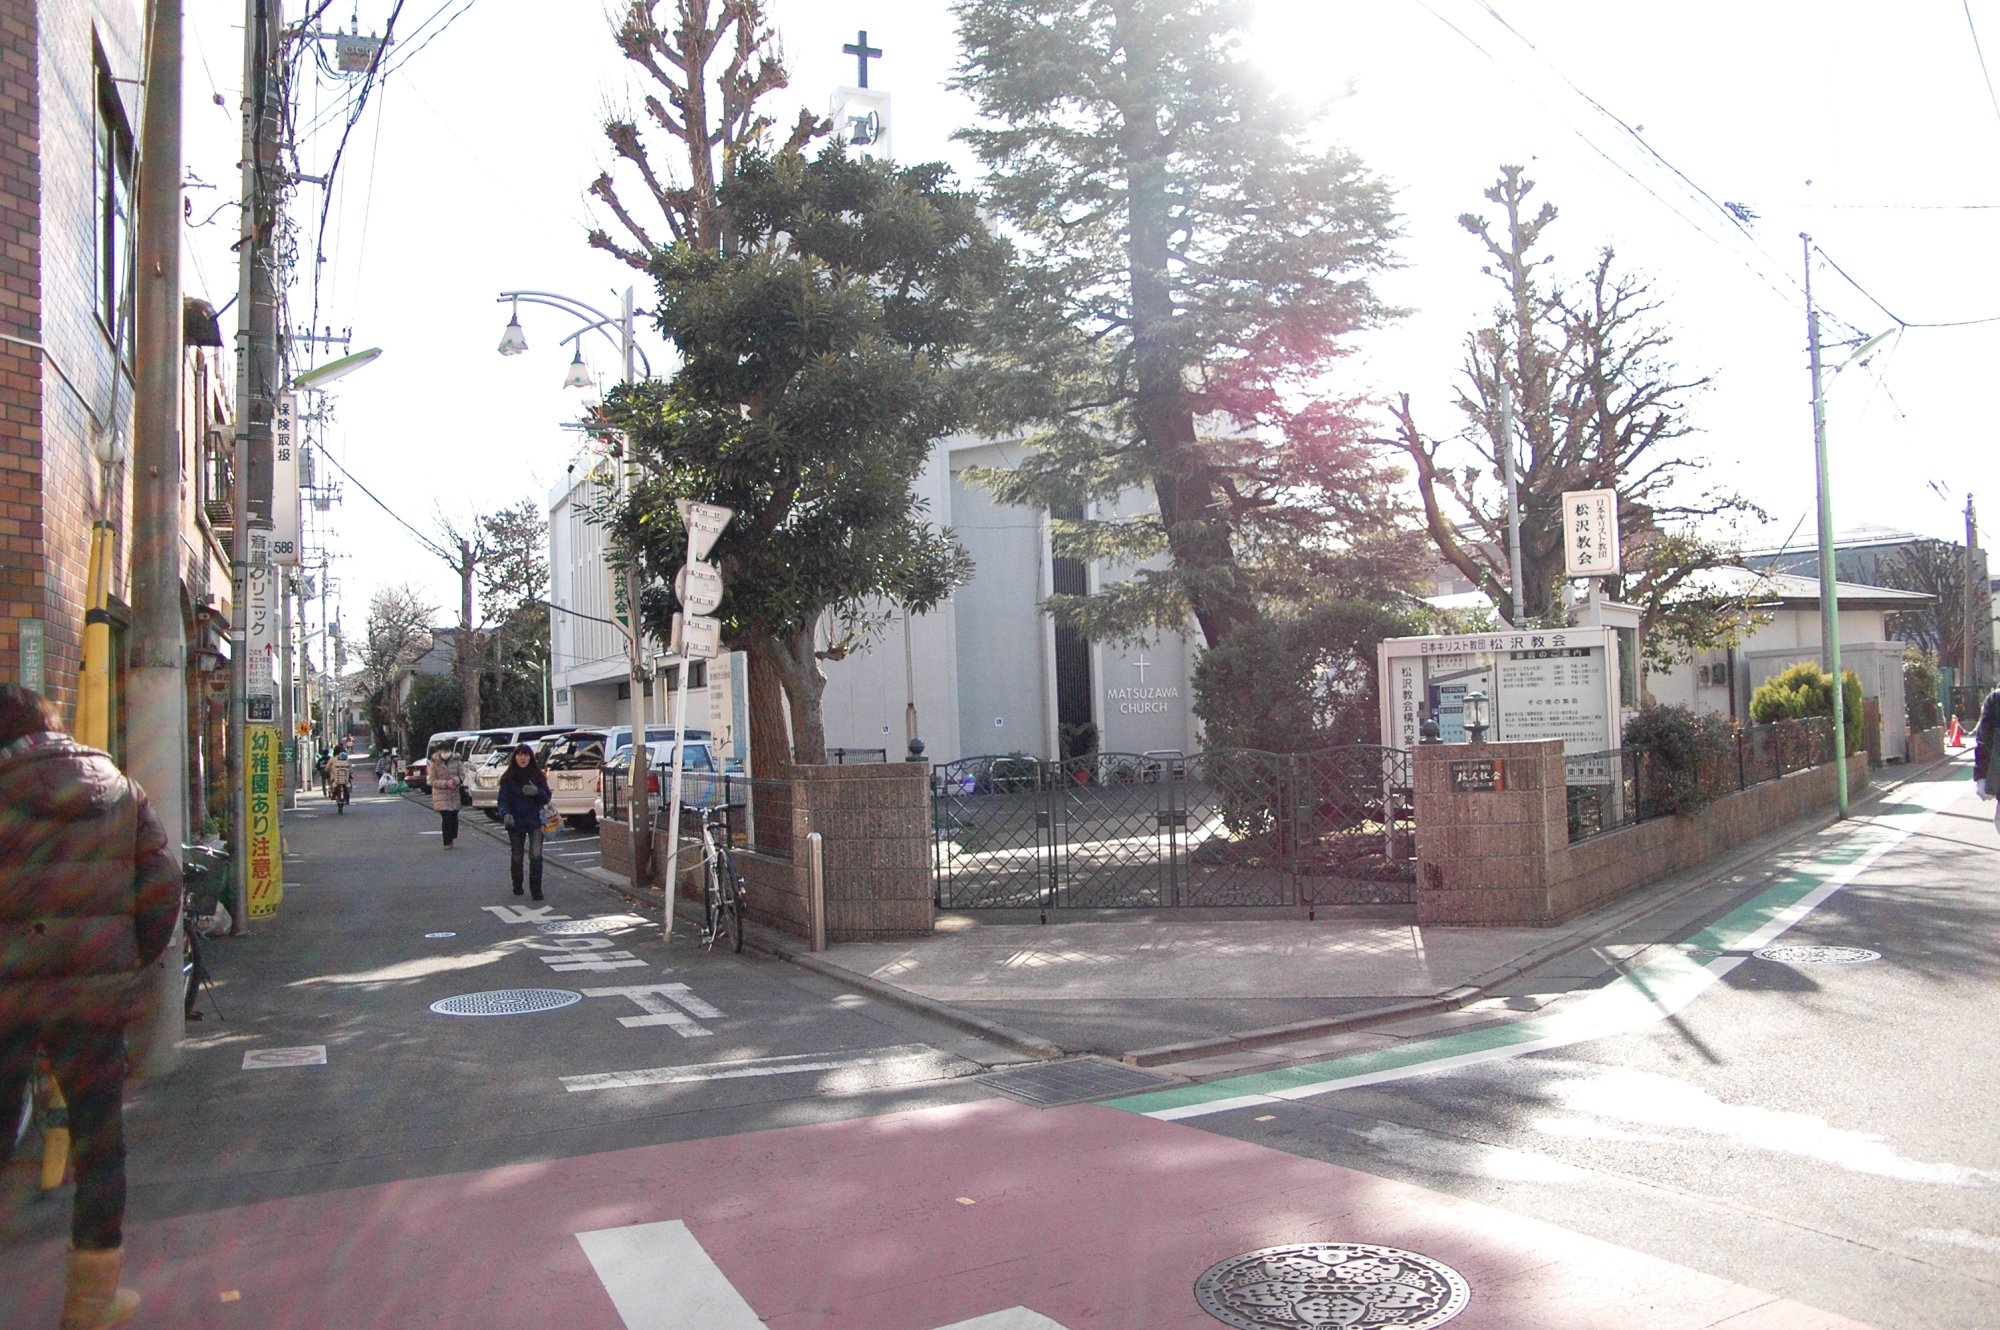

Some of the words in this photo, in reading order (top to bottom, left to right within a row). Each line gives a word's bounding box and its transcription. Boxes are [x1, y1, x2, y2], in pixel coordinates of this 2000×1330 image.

[1575, 503, 1592, 565] 松沢教会
[1596, 498, 1608, 559] 日本キリスト教団
[1421, 640, 1486, 654] 日本キリスト教団
[1489, 634, 1567, 651] 松沢教会
[1108, 687, 1179, 700] MATSUZAWA
[1120, 702, 1168, 714] CHURCH
